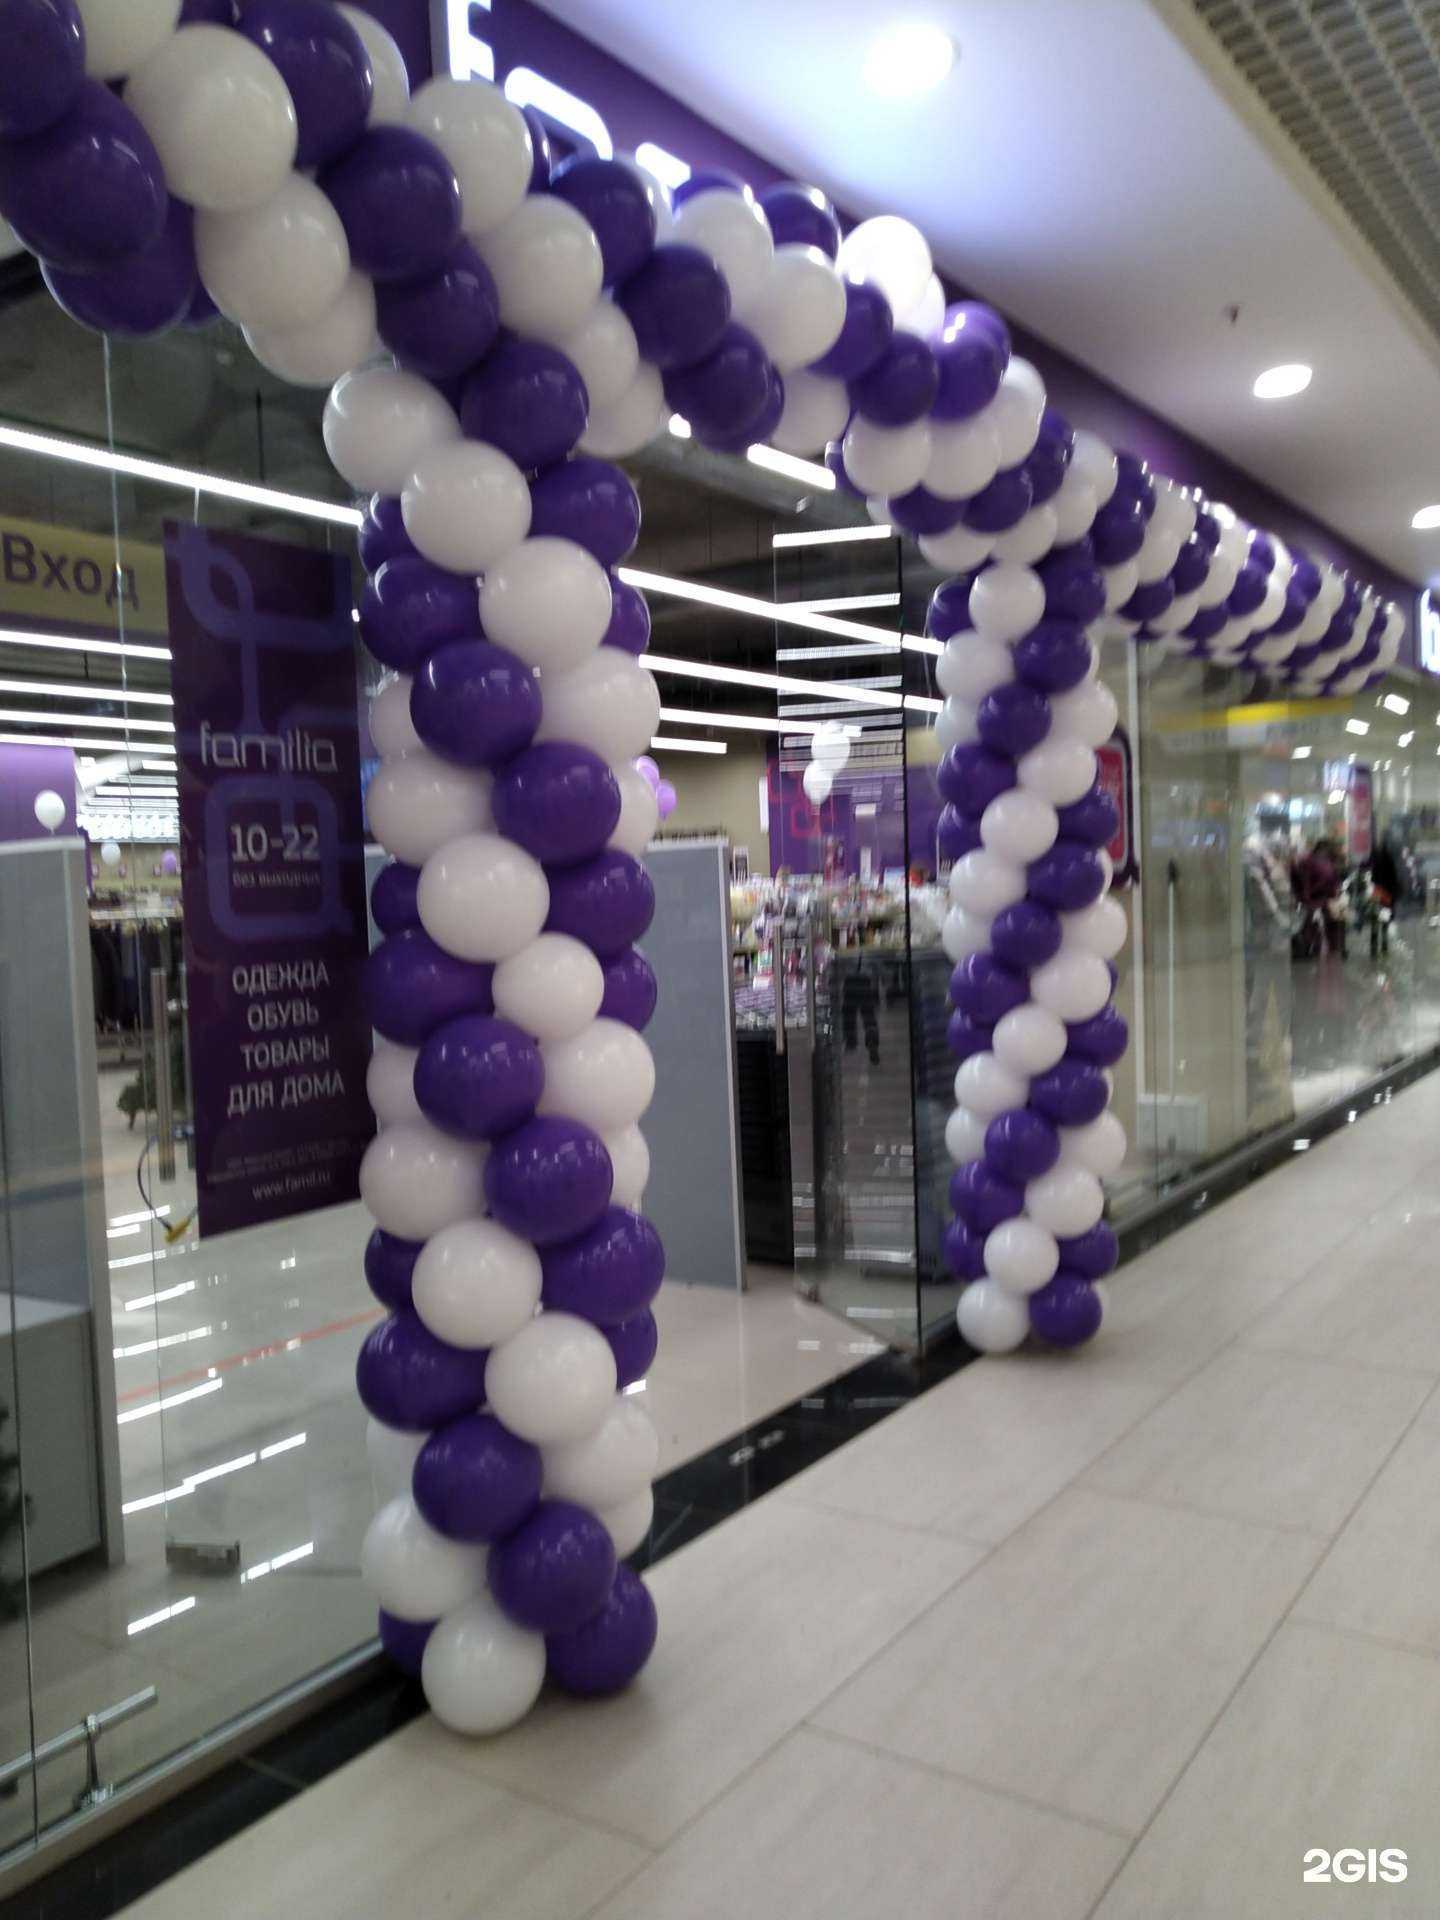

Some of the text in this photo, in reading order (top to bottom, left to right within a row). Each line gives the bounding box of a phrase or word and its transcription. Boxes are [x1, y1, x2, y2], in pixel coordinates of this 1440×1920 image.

[2, 533, 138, 610] Вход
[200, 721, 338, 772] familia
[230, 822, 321, 863] 10-22
[232, 959, 329, 997] ОДЕЖДА
[247, 999, 320, 1032] ОБУВЬ
[240, 1035, 330, 1072] ТОВАРЫ
[227, 1072, 345, 1118] ДЛЯ ДОМА
